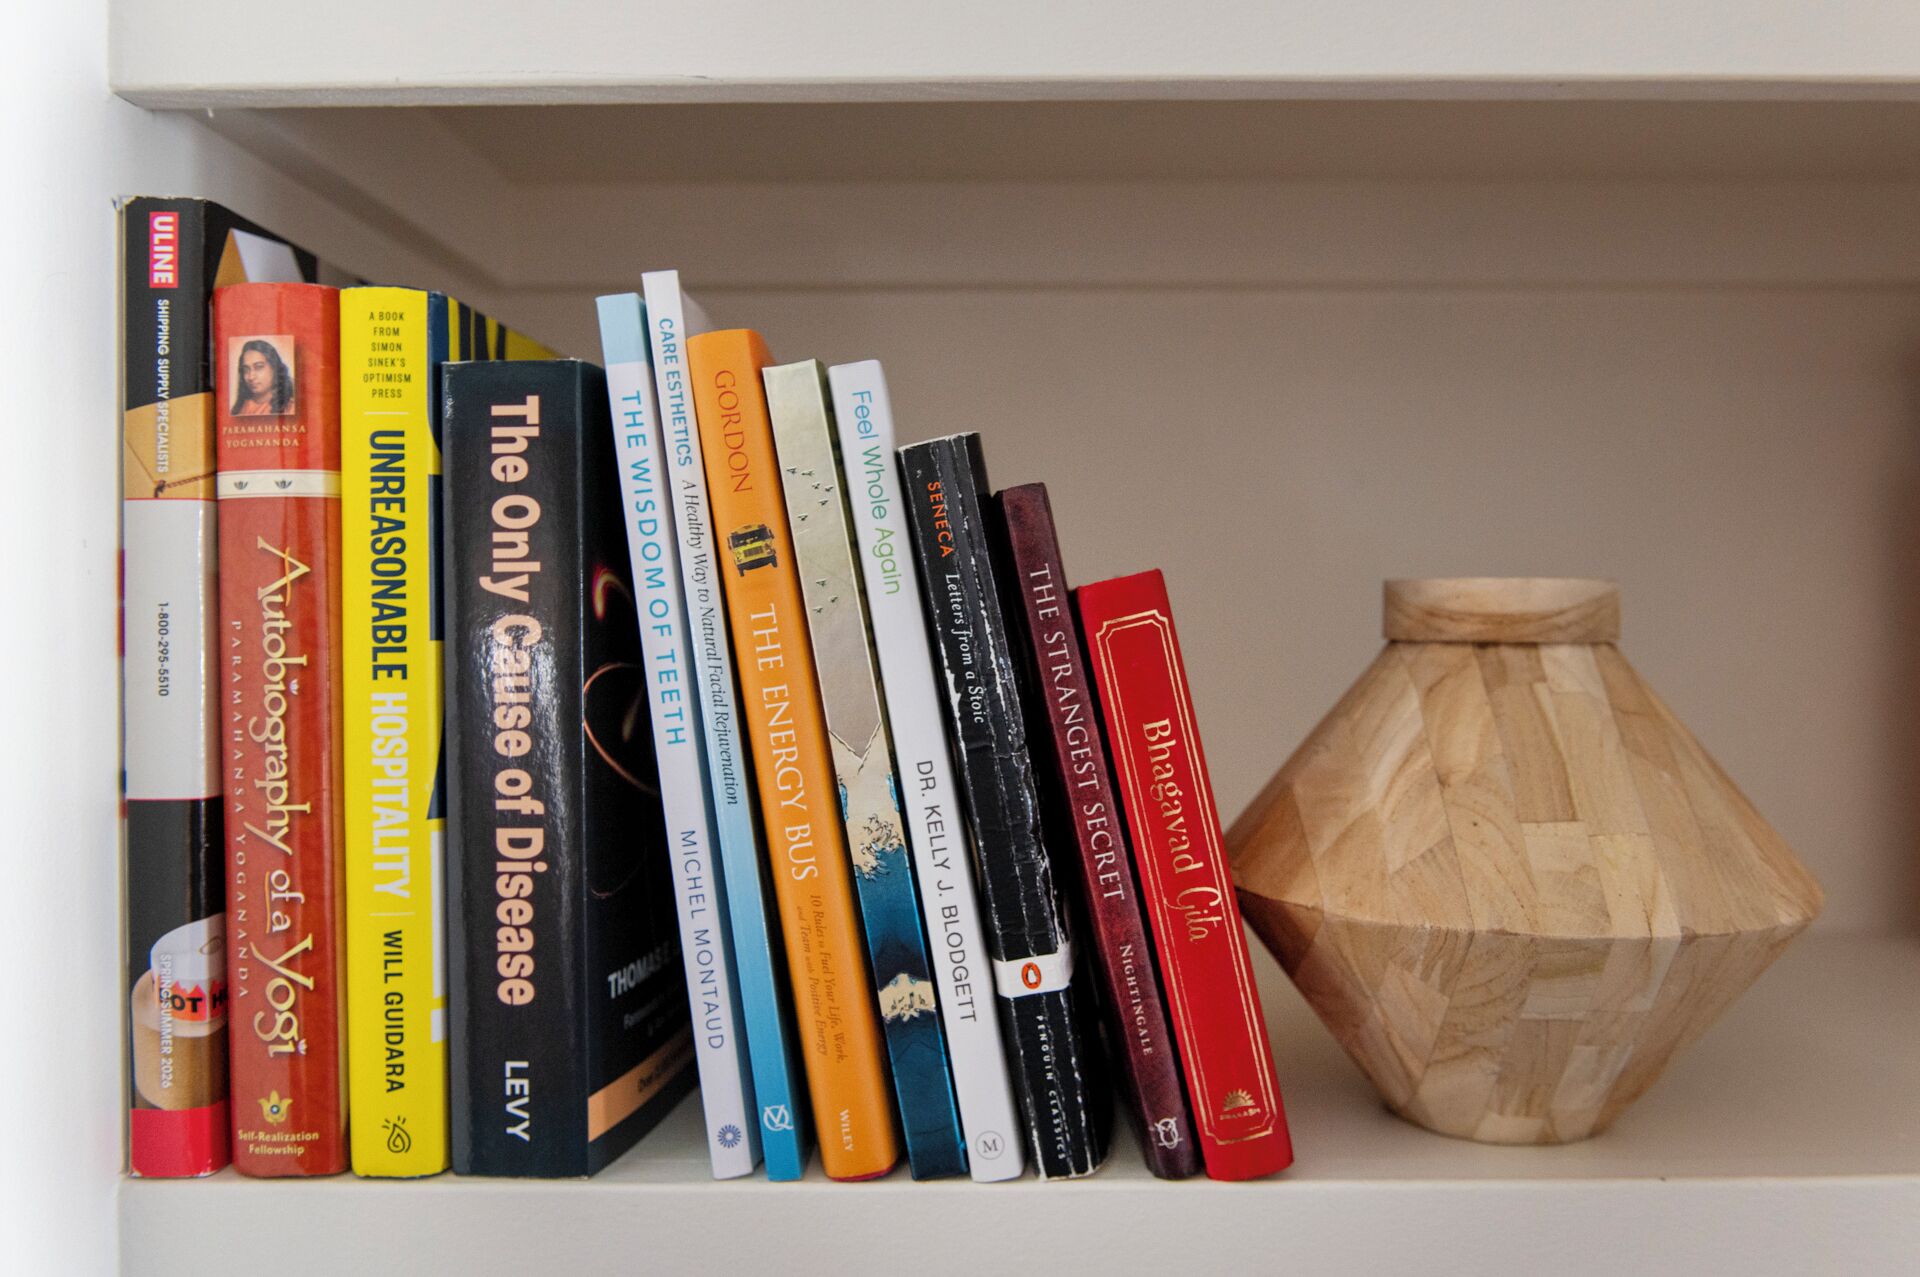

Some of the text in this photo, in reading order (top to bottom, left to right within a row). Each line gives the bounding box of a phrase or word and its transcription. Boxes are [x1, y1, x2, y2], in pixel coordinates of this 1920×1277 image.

[152, 215, 175, 284] ULINE
[368, 311, 405, 322] A BOOK
[368, 358, 407, 368] SINEK'S
[371, 343, 402, 352] SIMON
[373, 327, 401, 337] FROM
[156, 298, 170, 474] SHIPPING SUPPLY SPECIALISTS
[222, 424, 307, 435] PARAMAHANSA
[363, 373, 412, 383] OPTIMISM
[372, 388, 403, 398] PRESS
[714, 369, 753, 493] GORDON
[225, 438, 300, 448] YOGANANDA
[851, 390, 902, 595] Feel Whole Again
[622, 390, 687, 746] THE WISDOM OF TEETH
[658, 317, 738, 805] CARE ESTHETICS A Healthy Way to Natural Facial Rejuvenation
[927, 480, 955, 558] SENECA
[157, 602, 169, 697] 1-800-295-5510
[368, 430, 411, 899] UNREASONABLE HOSPITALITY
[479, 394, 548, 1006] The Only Cause of Disease
[945, 573, 988, 724] Letters from a Stoic
[750, 602, 819, 881] THE ENERGY BUS
[1029, 563, 1125, 901] THE STRANGEST SECRET
[231, 619, 249, 998] PARAMAHANSA YOGANANDA
[244, 535, 315, 1058] Autobiography of a Yogi
[1142, 718, 1223, 943] Bhagavad Gita
[680, 830, 725, 1050] MICHEL MONTAUD
[812, 910, 827, 938] Rules
[916, 760, 977, 1024] DR. KELLY J. BLODGETT
[383, 929, 405, 1093] WILL GUIDARA
[799, 923, 812, 953] Team
[808, 976, 821, 1017] Positive
[815, 1019, 829, 1057] Energy
[820, 952, 834, 975] Fuel
[824, 977, 838, 1003] Your
[1119, 944, 1153, 1056] NIGHTINGALE
[238, 1129, 320, 1143] Self-Realization
[505, 1060, 531, 1142] LEVY
[839, 1109, 854, 1152] WILEY
[1035, 1015, 1066, 1160] PENGUIN CLASSICS
[248, 1143, 305, 1156] Fellowship
